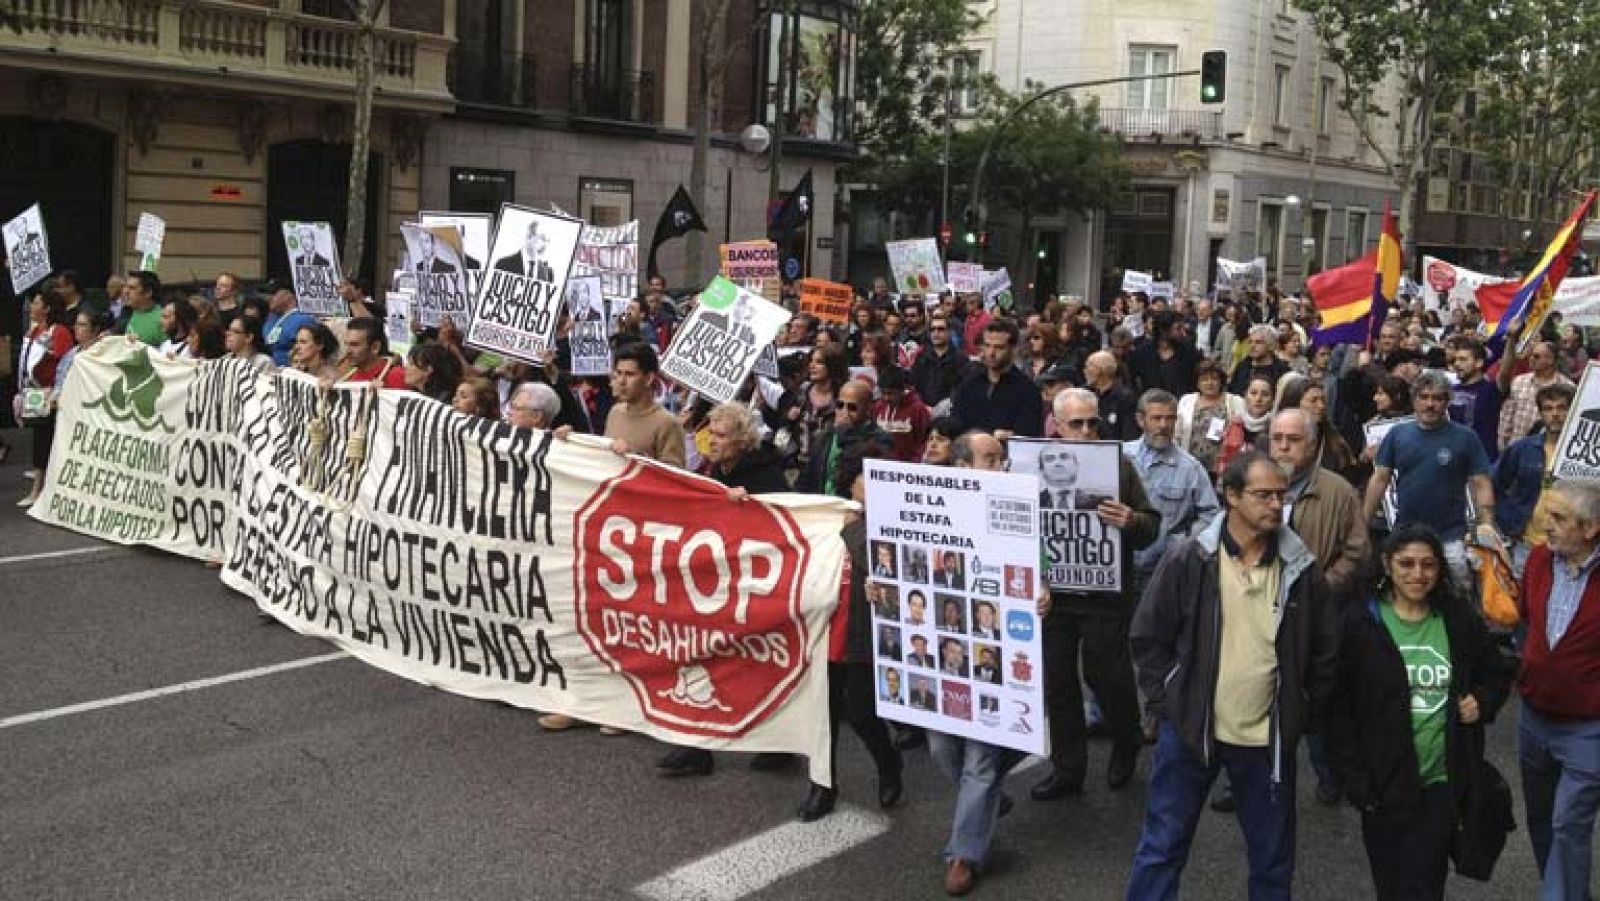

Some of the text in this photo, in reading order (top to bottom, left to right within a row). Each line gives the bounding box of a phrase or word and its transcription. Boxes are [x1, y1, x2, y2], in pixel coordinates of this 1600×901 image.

[728, 250, 778, 262] BANCOS
[489, 270, 542, 307] JUICIO
[544, 283, 558, 309] Y
[479, 291, 550, 335] CASTIGO
[676, 335, 745, 385] CASTIGO
[690, 319, 741, 354] JUICIO
[742, 345, 757, 362] Y
[70, 420, 171, 478] PLATAFORMA
[57, 458, 166, 514] DE AFECTADOS
[374, 396, 554, 546] FINANCIERA
[870, 469, 982, 491] RESPONSABLES
[50, 493, 77, 522] POR
[76, 499, 99, 531] LA
[900, 510, 952, 527] ESTAFA
[904, 491, 945, 507] DE LA
[175, 437, 246, 505] CONRA
[262, 483, 334, 570] ESTAFA
[344, 515, 554, 623] HIPOTECARIA
[880, 526, 975, 550] HIPOTECARIA
[1040, 511, 1091, 541] ICIO
[597, 515, 784, 625] STOP
[1047, 537, 1115, 566] STIGO
[171, 496, 567, 690] POR DERECHO A LA VIVIENDA
[602, 607, 791, 669] DESAHUCIOS
[1405, 664, 1449, 687] TOP
